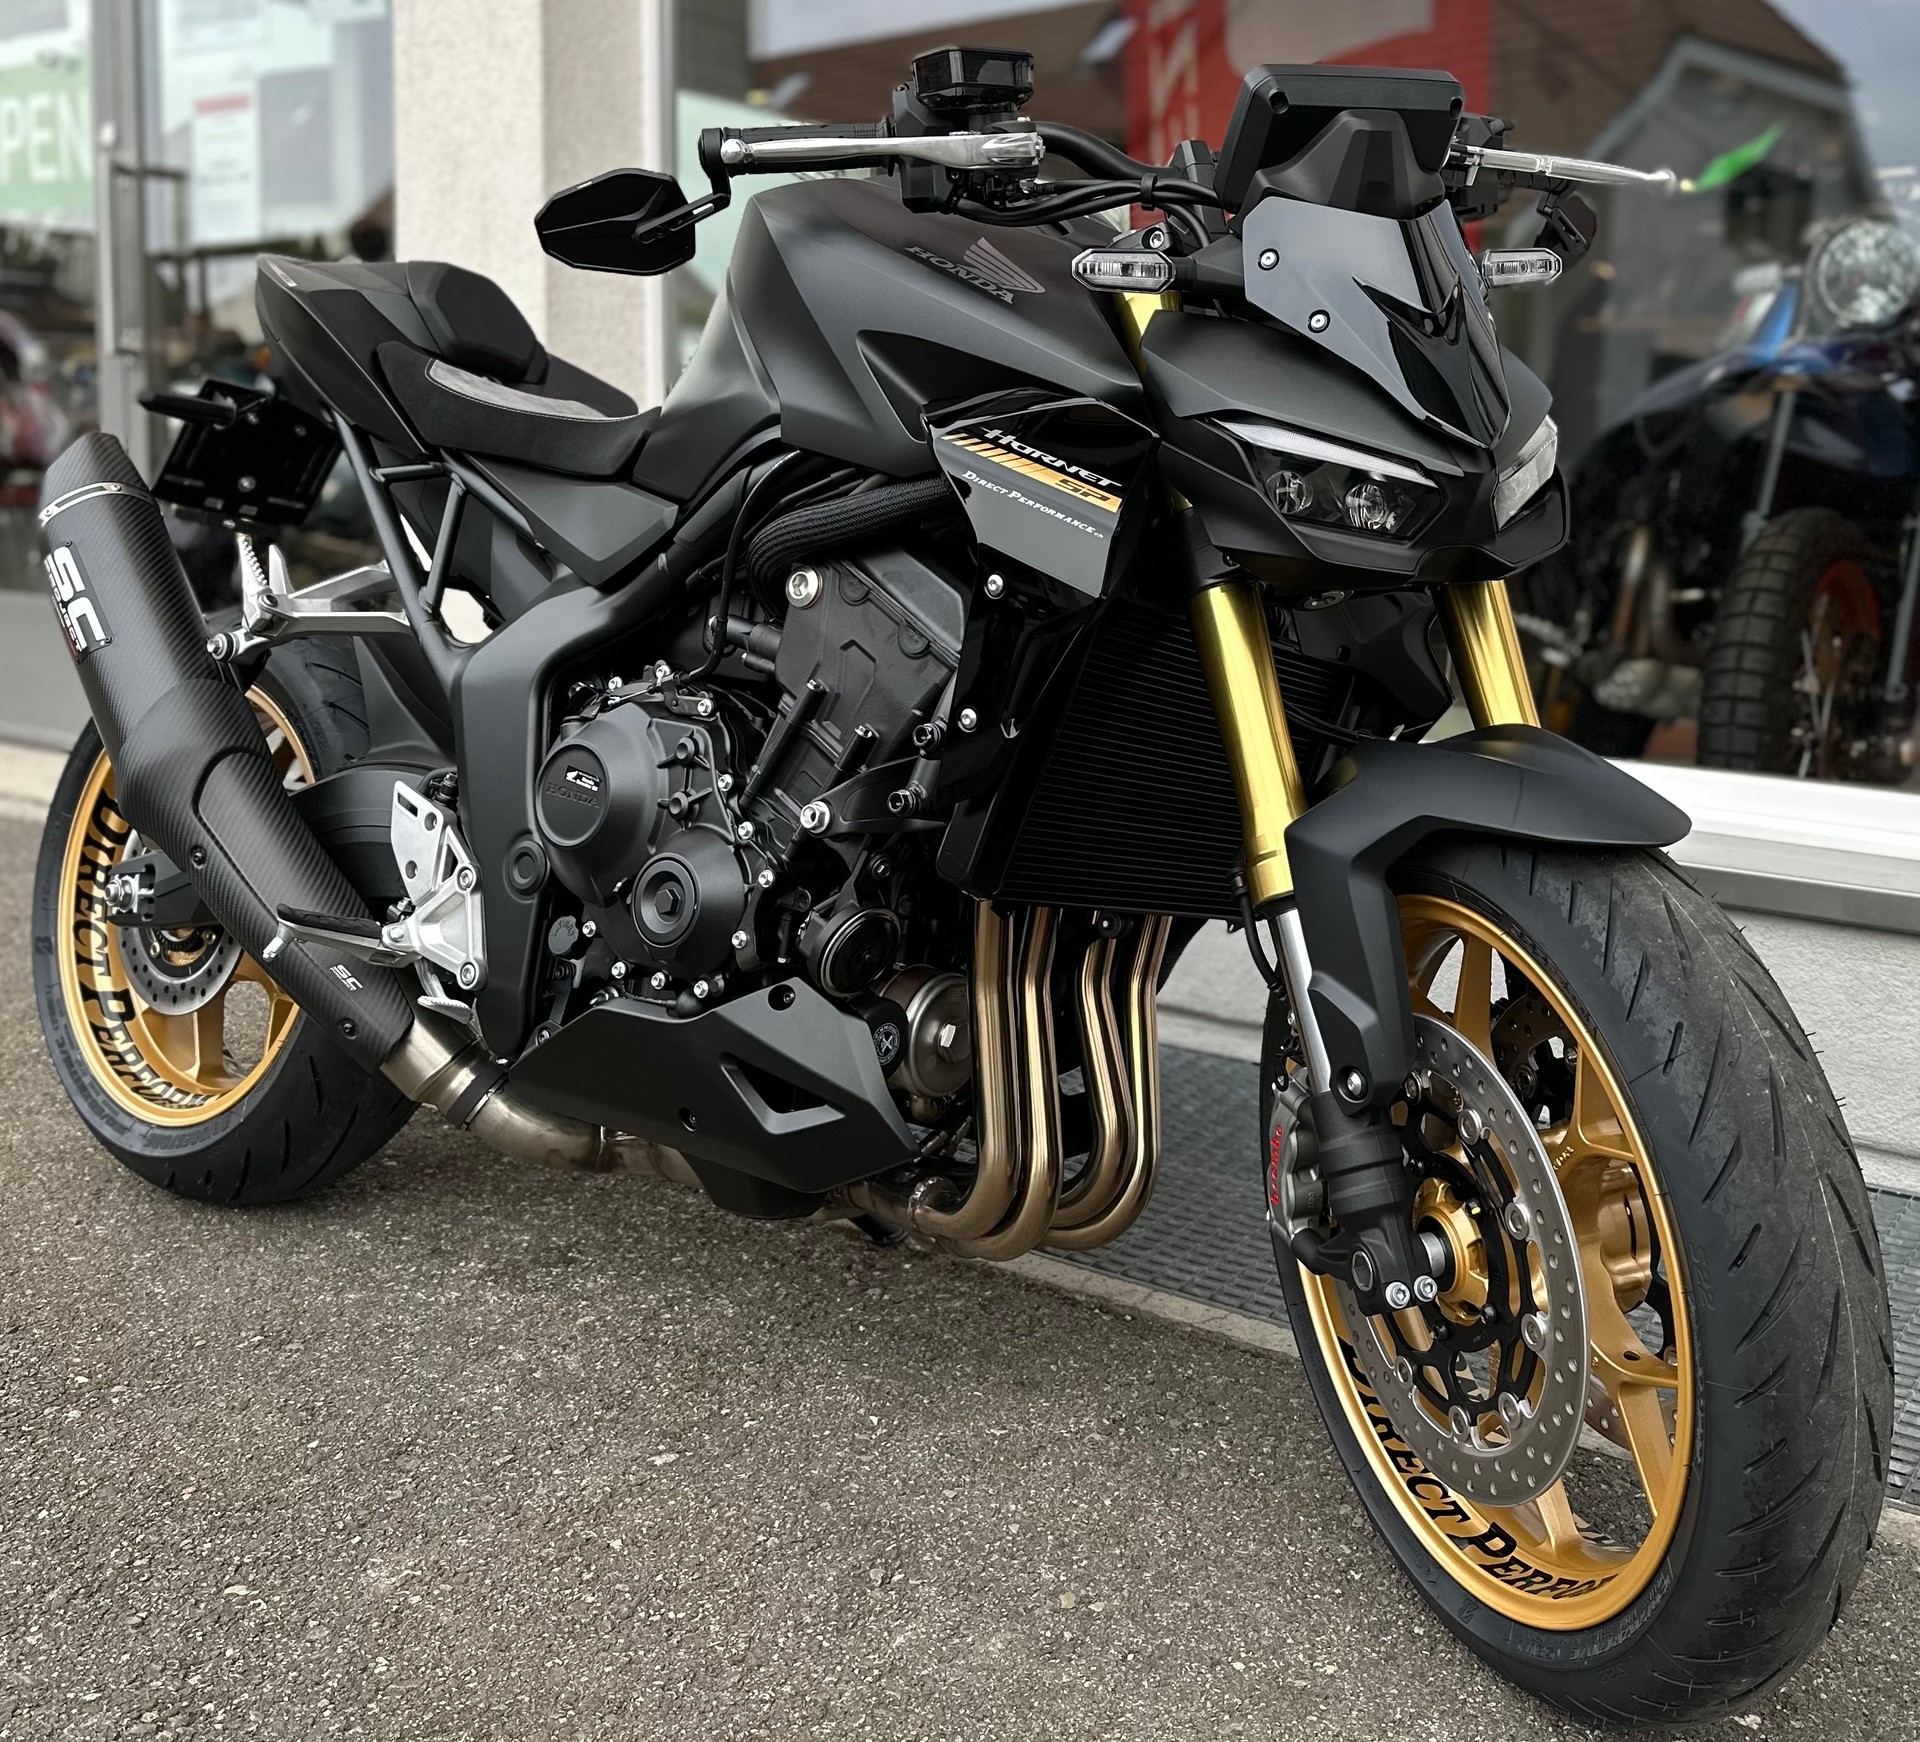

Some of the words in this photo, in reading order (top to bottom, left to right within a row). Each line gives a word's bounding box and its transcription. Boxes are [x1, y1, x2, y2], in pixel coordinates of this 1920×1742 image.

[904, 246, 1014, 304] HONDA
[980, 426, 1122, 487] HORNET
[1055, 478, 1111, 503] SP
[46, 546, 106, 650] SC
[545, 781, 600, 808] HONDA
[1270, 1123, 1283, 1205] brembo
